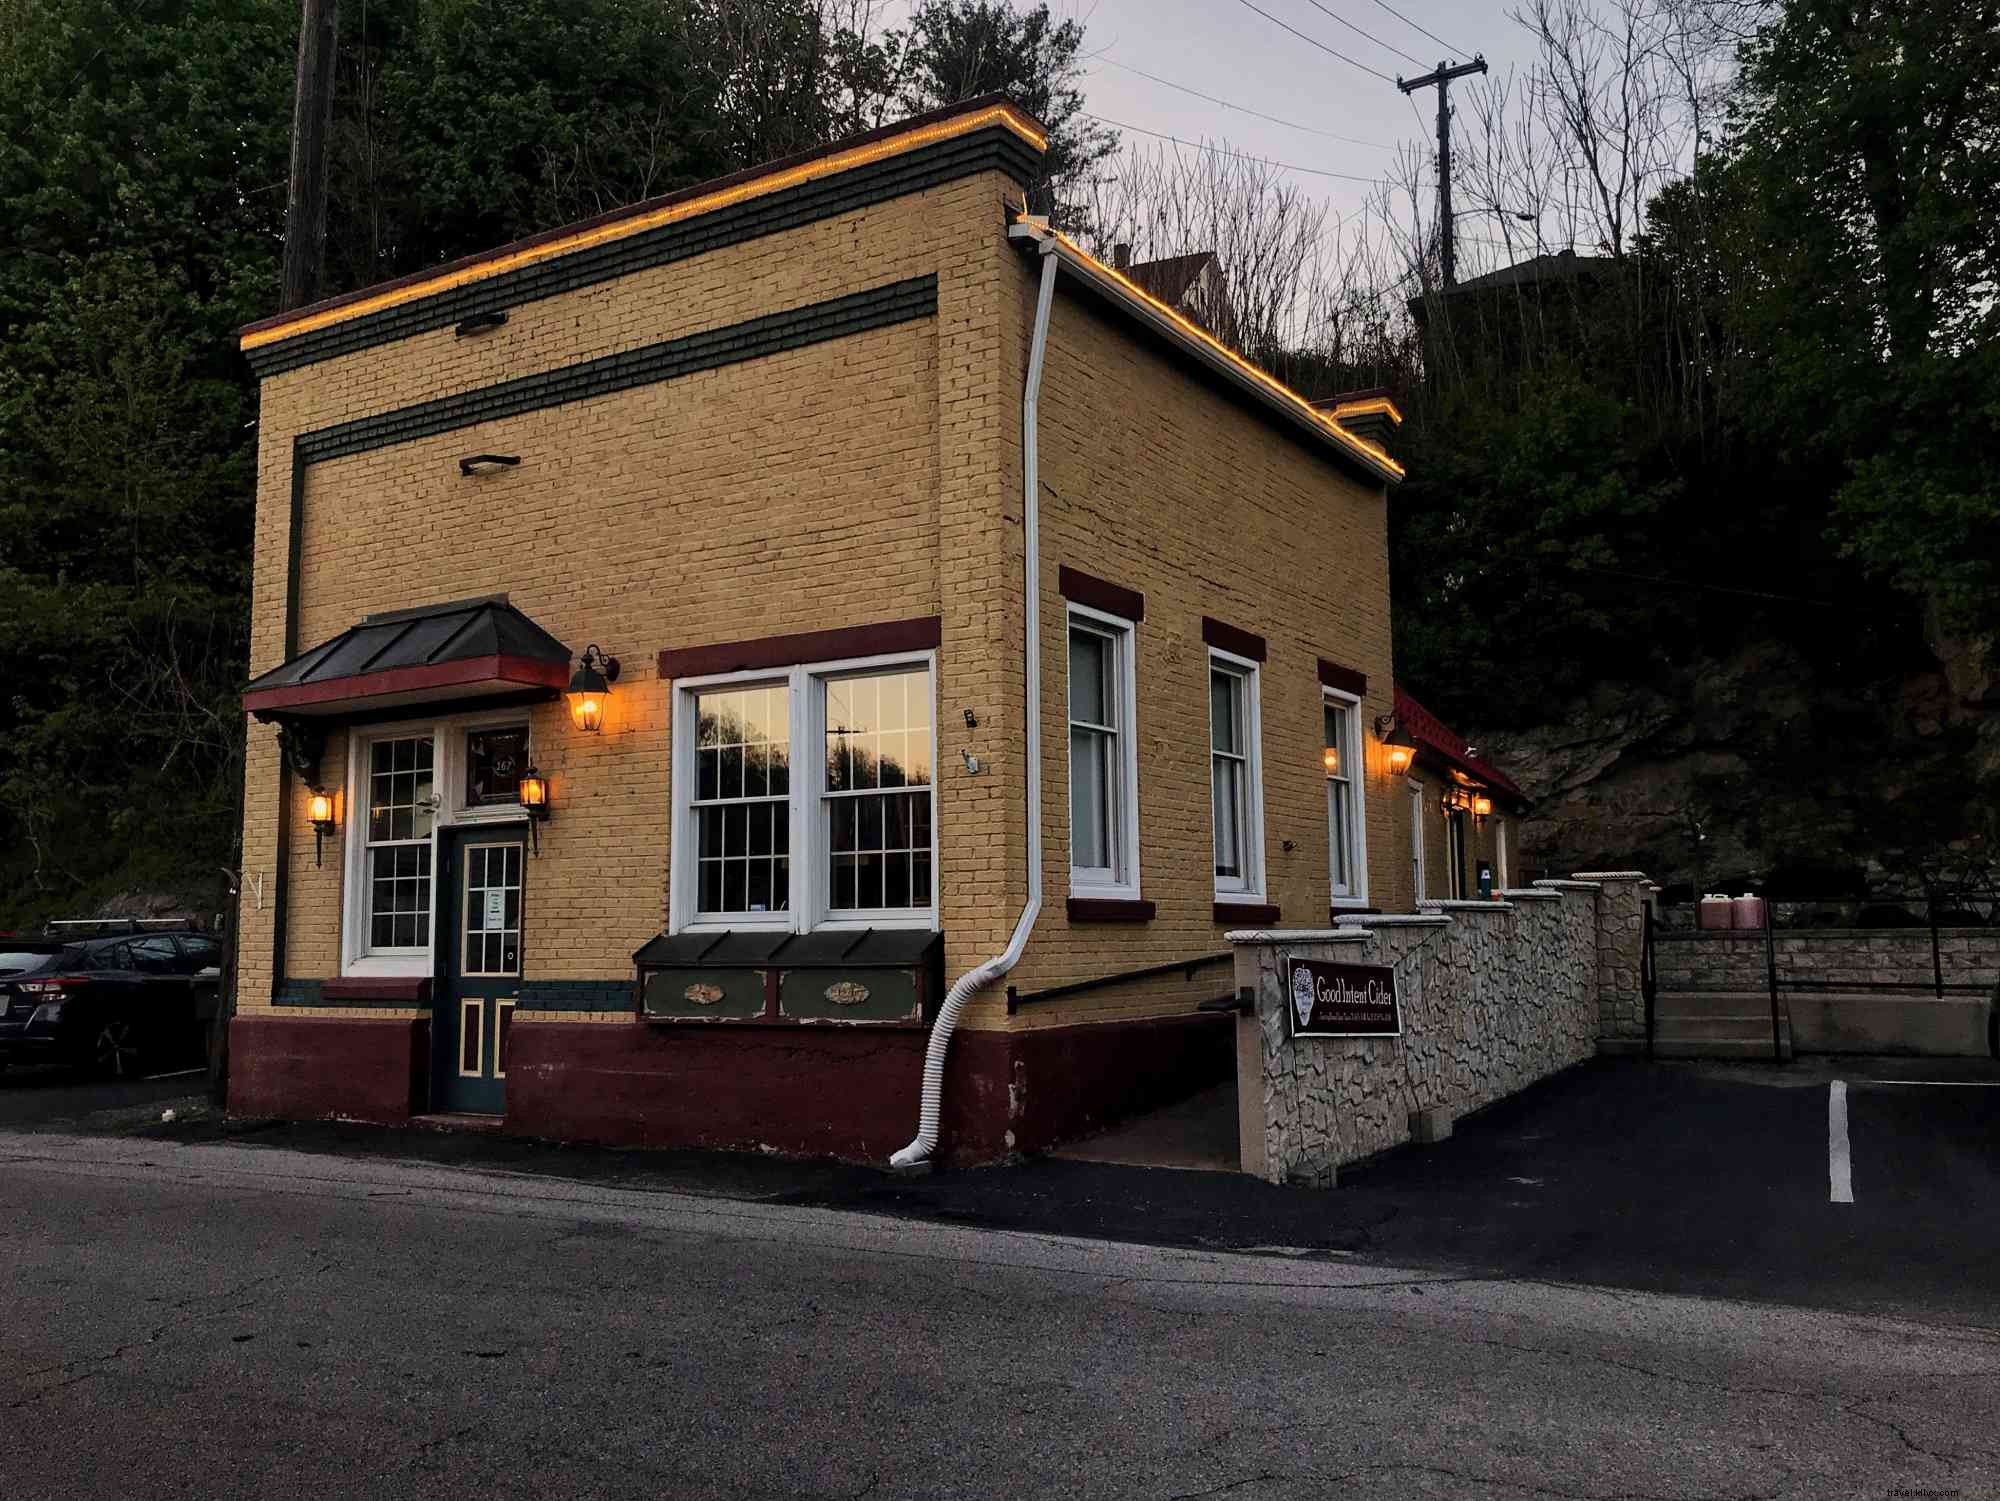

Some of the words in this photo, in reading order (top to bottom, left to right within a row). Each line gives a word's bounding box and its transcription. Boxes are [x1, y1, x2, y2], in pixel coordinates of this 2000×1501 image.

[1316, 975, 1340, 1003] Good
[1340, 978, 1367, 1004] Intent
[1368, 979, 1391, 1005] Cider
